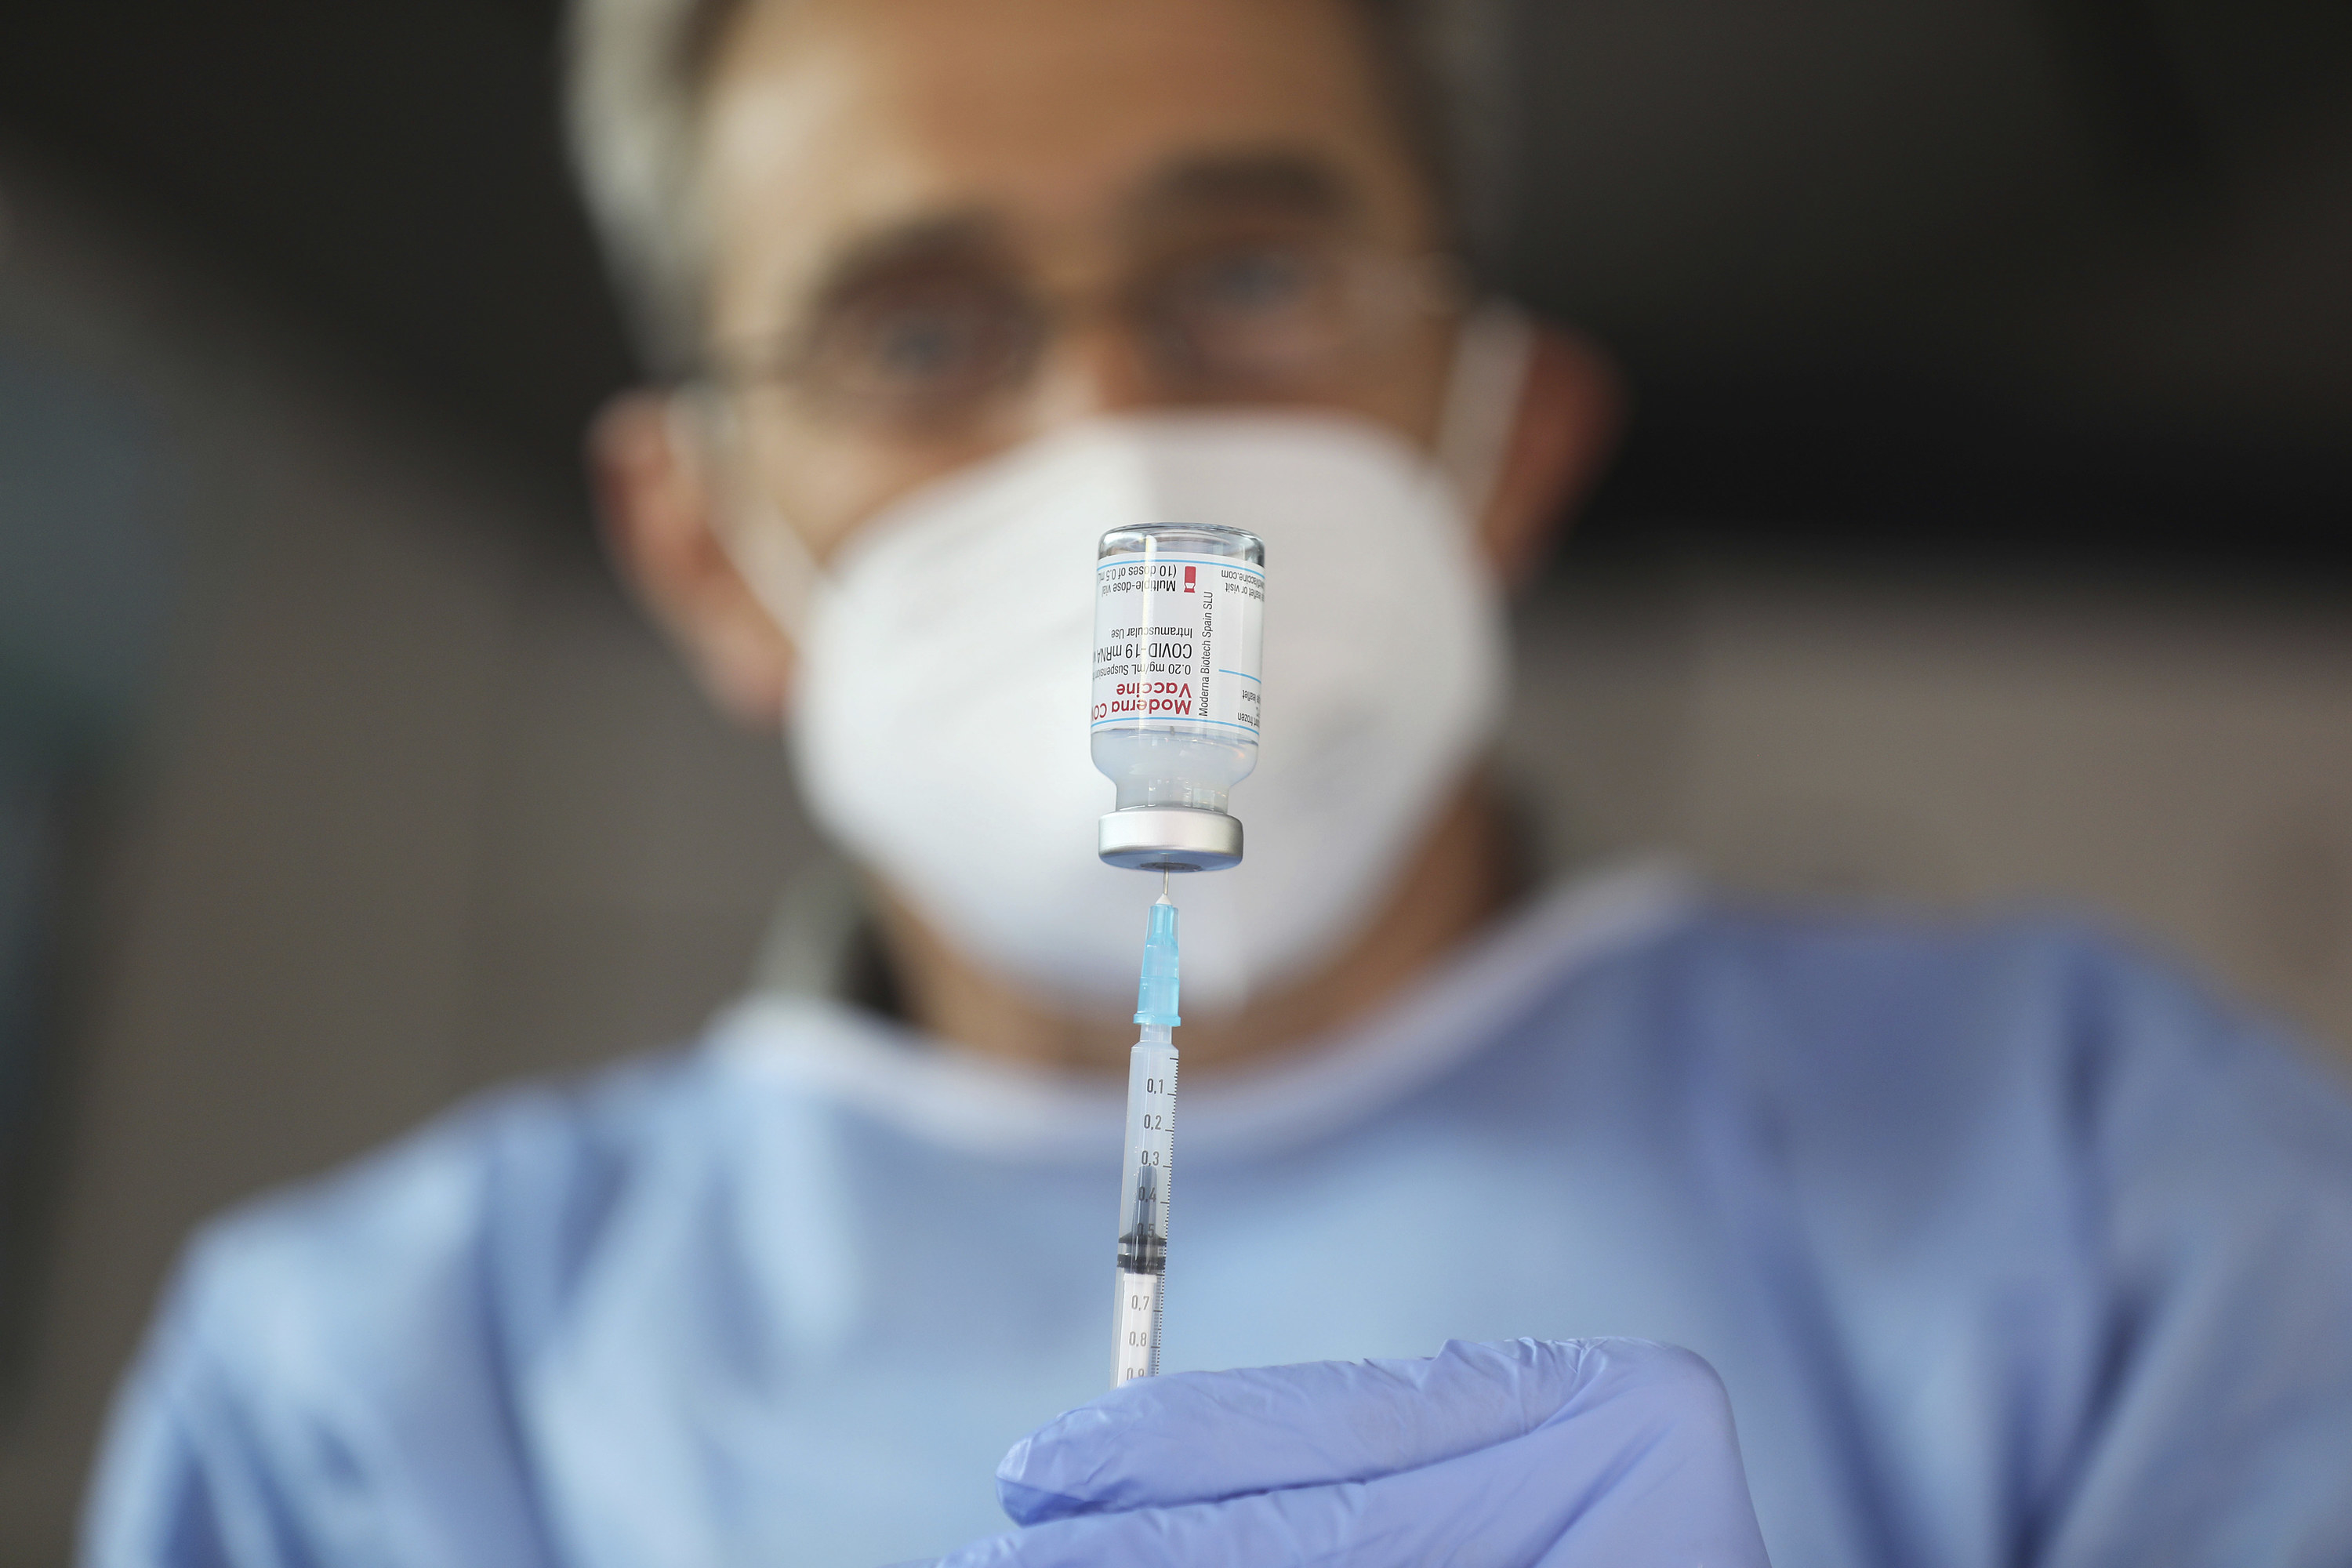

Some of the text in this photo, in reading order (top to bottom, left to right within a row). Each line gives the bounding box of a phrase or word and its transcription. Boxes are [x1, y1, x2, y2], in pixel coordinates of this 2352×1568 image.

[1105, 569, 1116, 582] 0.5
[1116, 568, 1126, 579] of
[1128, 565, 1156, 579] doses
[1160, 564, 1176, 577] (10
[1102, 579, 1176, 597] Multiple-dose vial
[1225, 583, 1240, 593] visit
[1111, 626, 1192, 638] Intramuscular Use
[1097, 644, 1122, 663] mRNA
[1125, 642, 1192, 659] COVID-19
[1199, 591, 1213, 717] Moderna Biotech Spain SLU
[1131, 662, 1165, 675] mg/mL
[1168, 664, 1191, 674] 0.20
[1116, 682, 1191, 698] Vaccine
[1242, 690, 1256, 703] leaflet
[1112, 699, 1192, 716] Moderna
[1237, 713, 1253, 726] frozen
